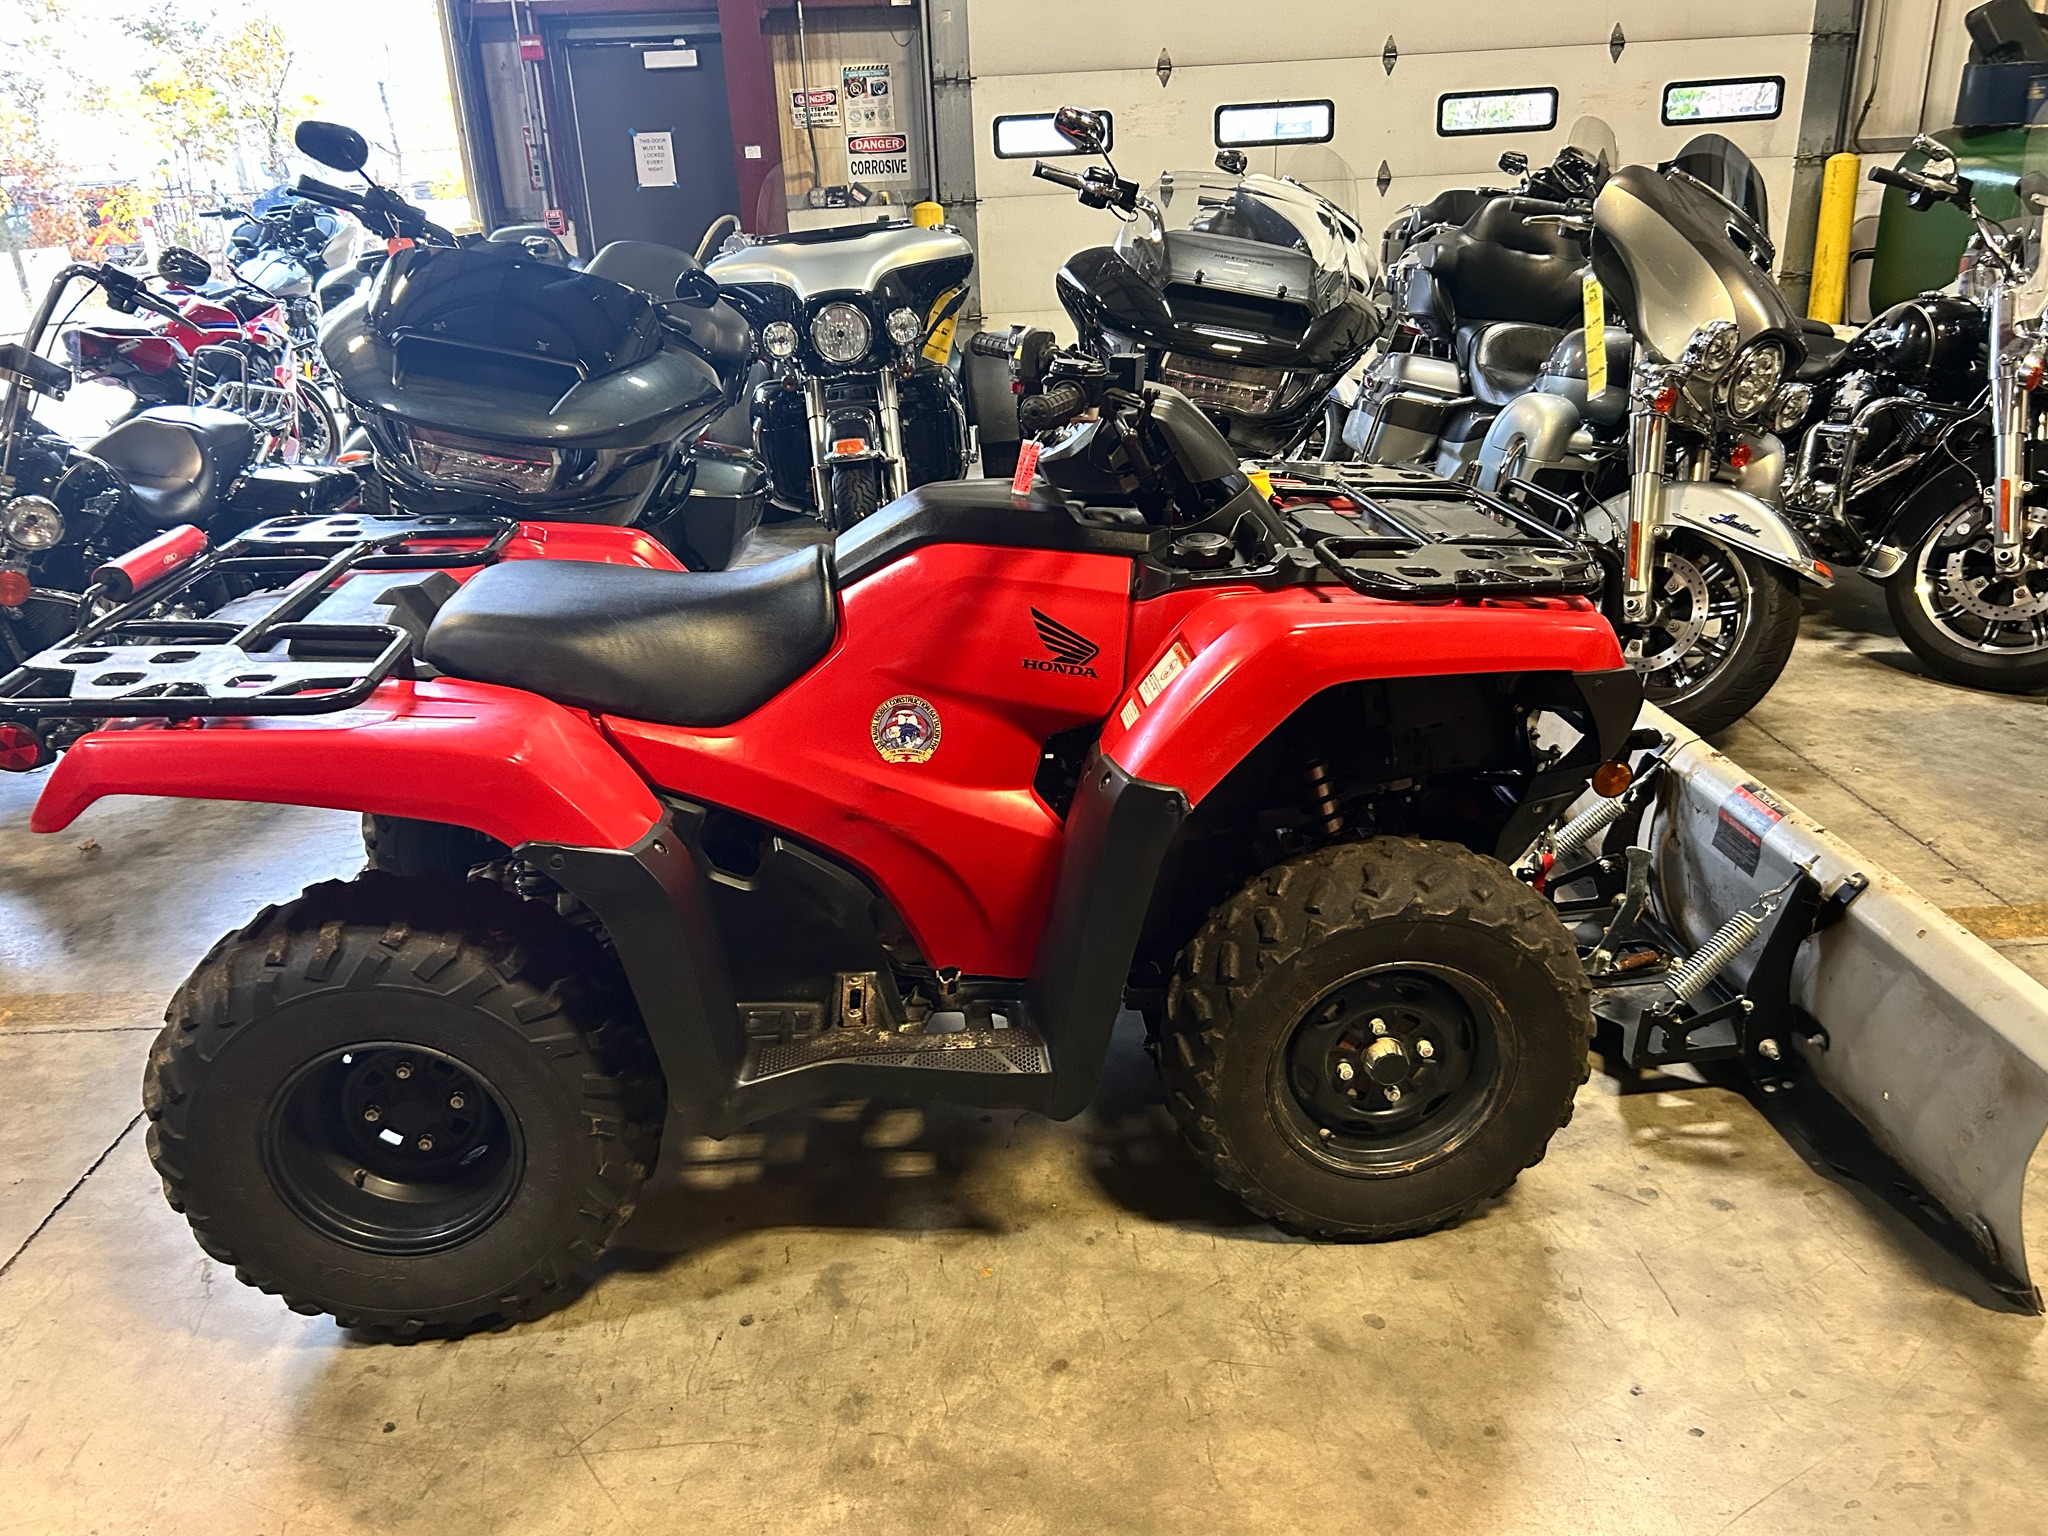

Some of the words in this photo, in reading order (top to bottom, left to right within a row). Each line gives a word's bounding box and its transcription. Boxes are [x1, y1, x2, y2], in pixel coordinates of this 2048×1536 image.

[798, 94, 832, 103] DNGER
[855, 140, 899, 150] DANGER
[851, 159, 907, 175] CORROSIVE
[1214, 254, 1274, 266] HARLEY-DAVIDSON
[1708, 514, 1762, 538] Limited
[1022, 659, 1098, 678] HONDA
[889, 697, 931, 711] CONSTRUCTION
